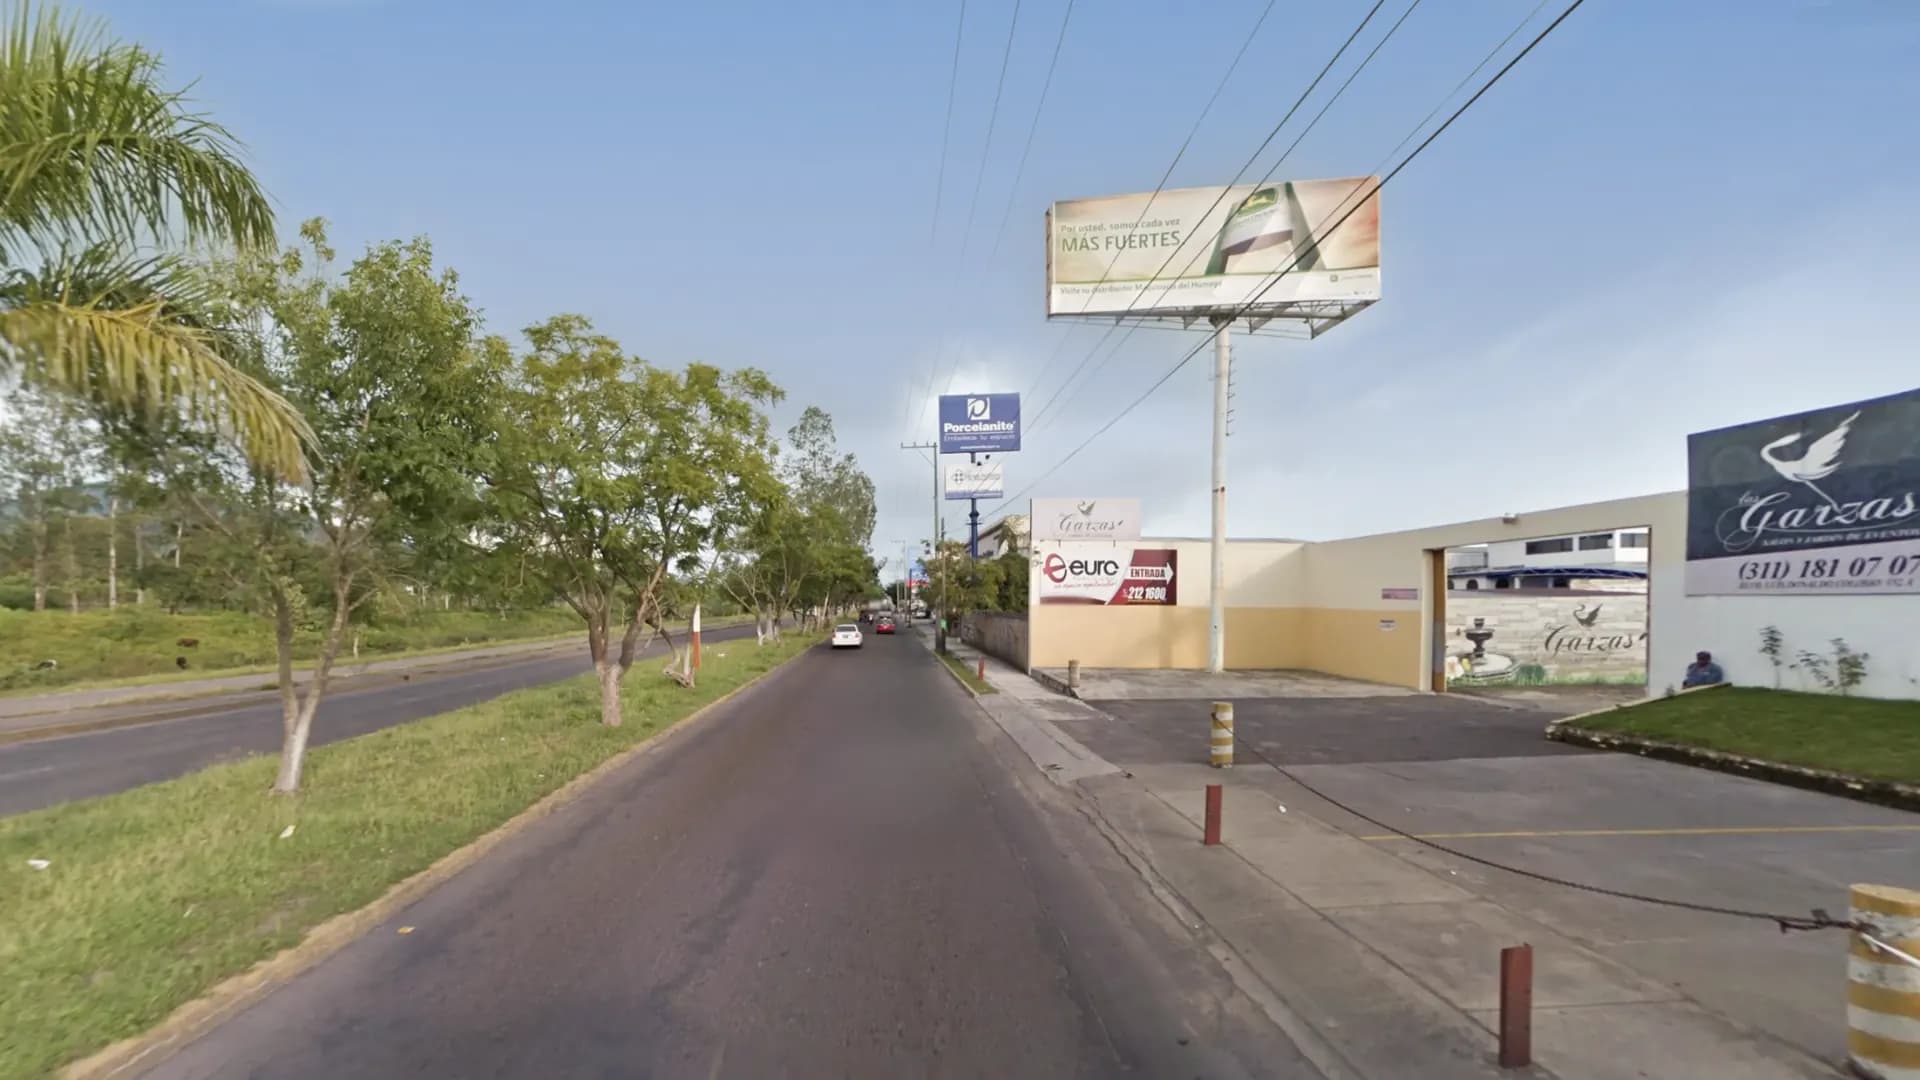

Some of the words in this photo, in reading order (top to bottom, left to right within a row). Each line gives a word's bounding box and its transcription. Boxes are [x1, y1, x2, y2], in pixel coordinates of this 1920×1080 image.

[1110, 221, 1139, 231] somos
[1141, 218, 1163, 228] cada
[1164, 218, 1181, 226] vez
[1061, 232, 1100, 252] MÁS
[1105, 230, 1181, 251] FUERTES
[943, 420, 1014, 432] Porcelanite
[1059, 513, 1117, 533] Garzas
[1734, 491, 1919, 541] Garzas
[1130, 568, 1166, 578] ENTRADA
[1738, 559, 1791, 580] (311)
[1799, 558, 1840, 579] 181
[1848, 556, 1884, 577] 07
[1888, 554, 1920, 576] 07
[1128, 586, 1144, 599] 212
[1145, 587, 1167, 600] 1600
[1545, 624, 1635, 657] Garzas
